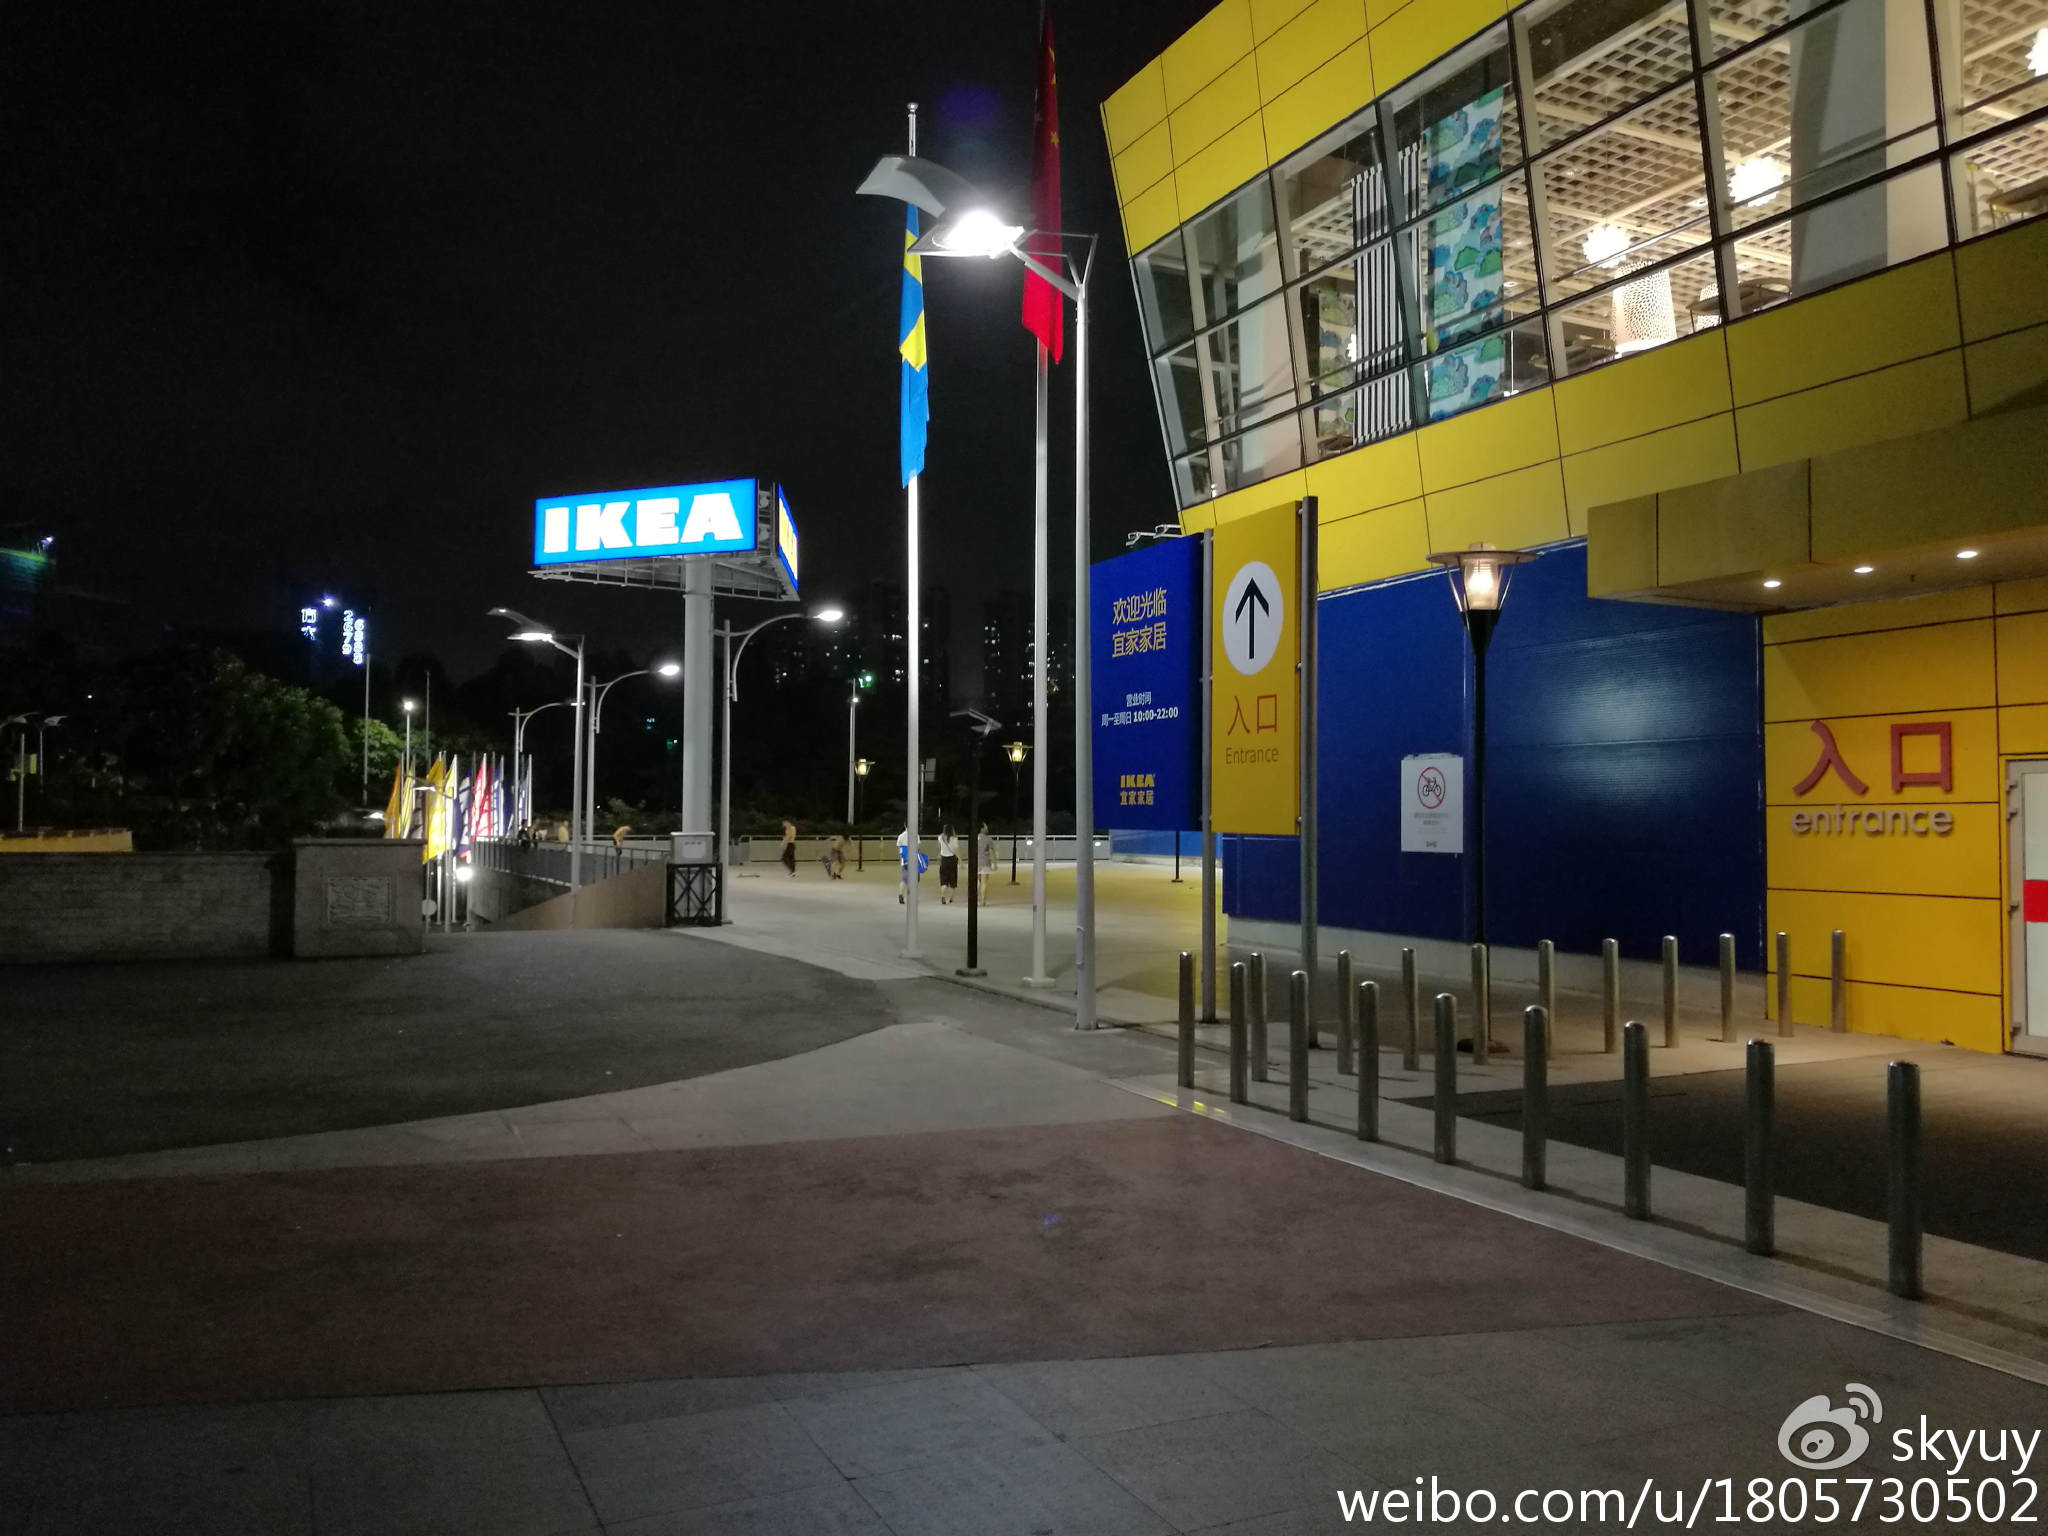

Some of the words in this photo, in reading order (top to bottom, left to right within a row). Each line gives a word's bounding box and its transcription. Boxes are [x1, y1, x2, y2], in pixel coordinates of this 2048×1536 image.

[544, 492, 743, 553] IKEA
[1112, 587, 1167, 624] 欢迎光临
[1112, 622, 1167, 658] 宜家家居
[1126, 691, 1152, 707] 营业时间
[1133, 706, 1178, 722] 10:00-22:00
[1227, 694, 1278, 736] 入口
[1226, 747, 1280, 765] Entrance
[1792, 719, 1953, 796] 入口
[1120, 774, 1155, 789] IKEA
[1790, 804, 1954, 834] entrance
